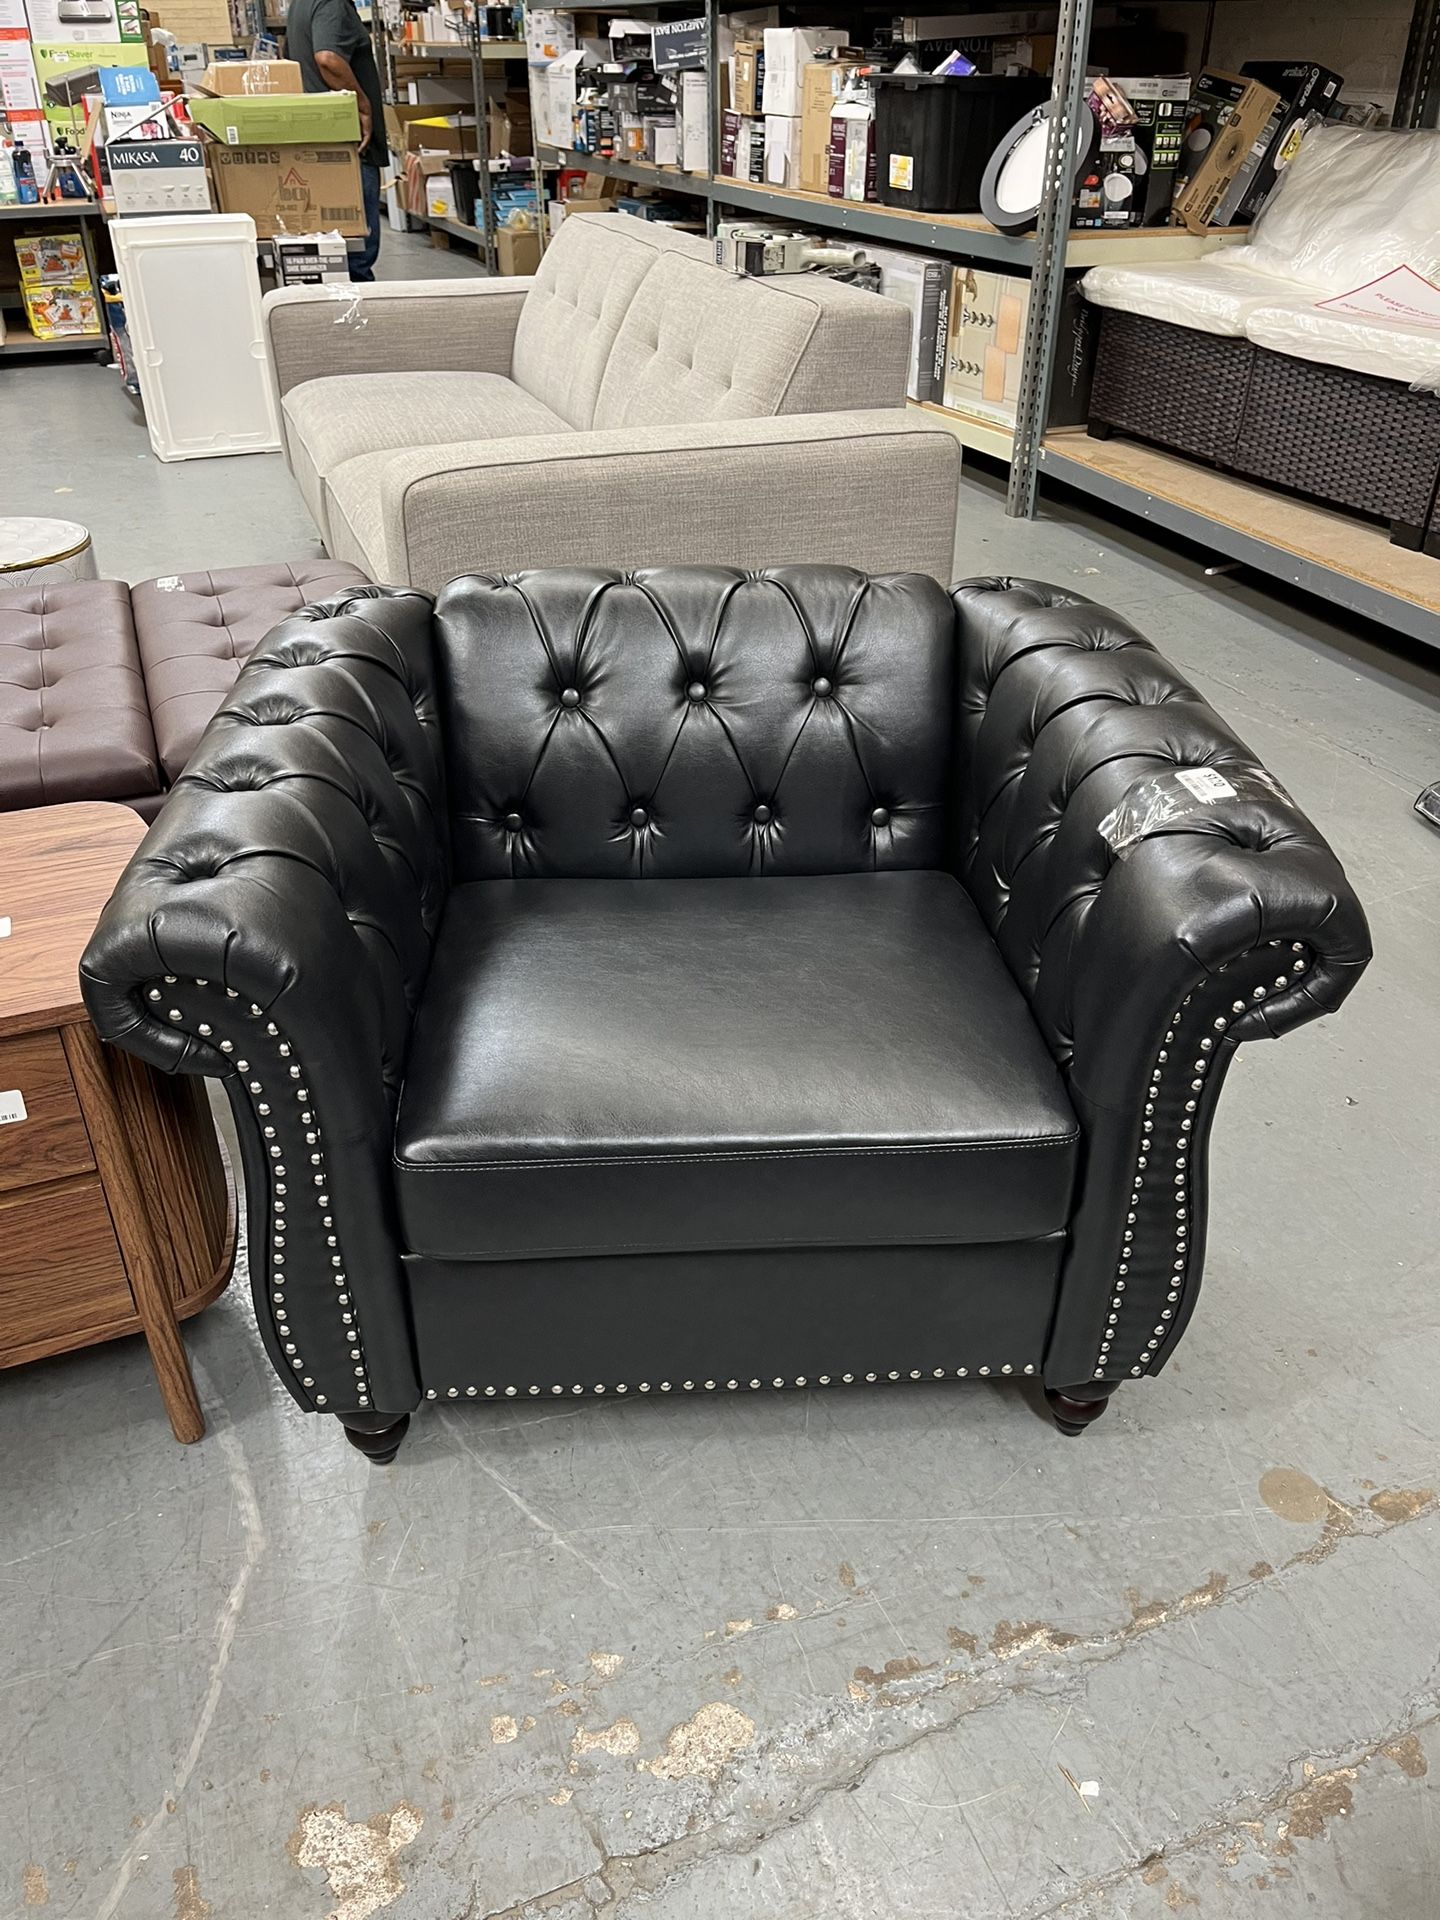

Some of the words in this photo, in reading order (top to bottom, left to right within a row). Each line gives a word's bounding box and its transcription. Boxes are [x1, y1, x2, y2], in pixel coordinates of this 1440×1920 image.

[655, 26, 671, 36] BAY
[671, 19, 706, 34] AMPTON
[110, 110, 132, 120] NINJA
[113, 151, 160, 166] MIKASA
[180, 146, 199, 162] 40
